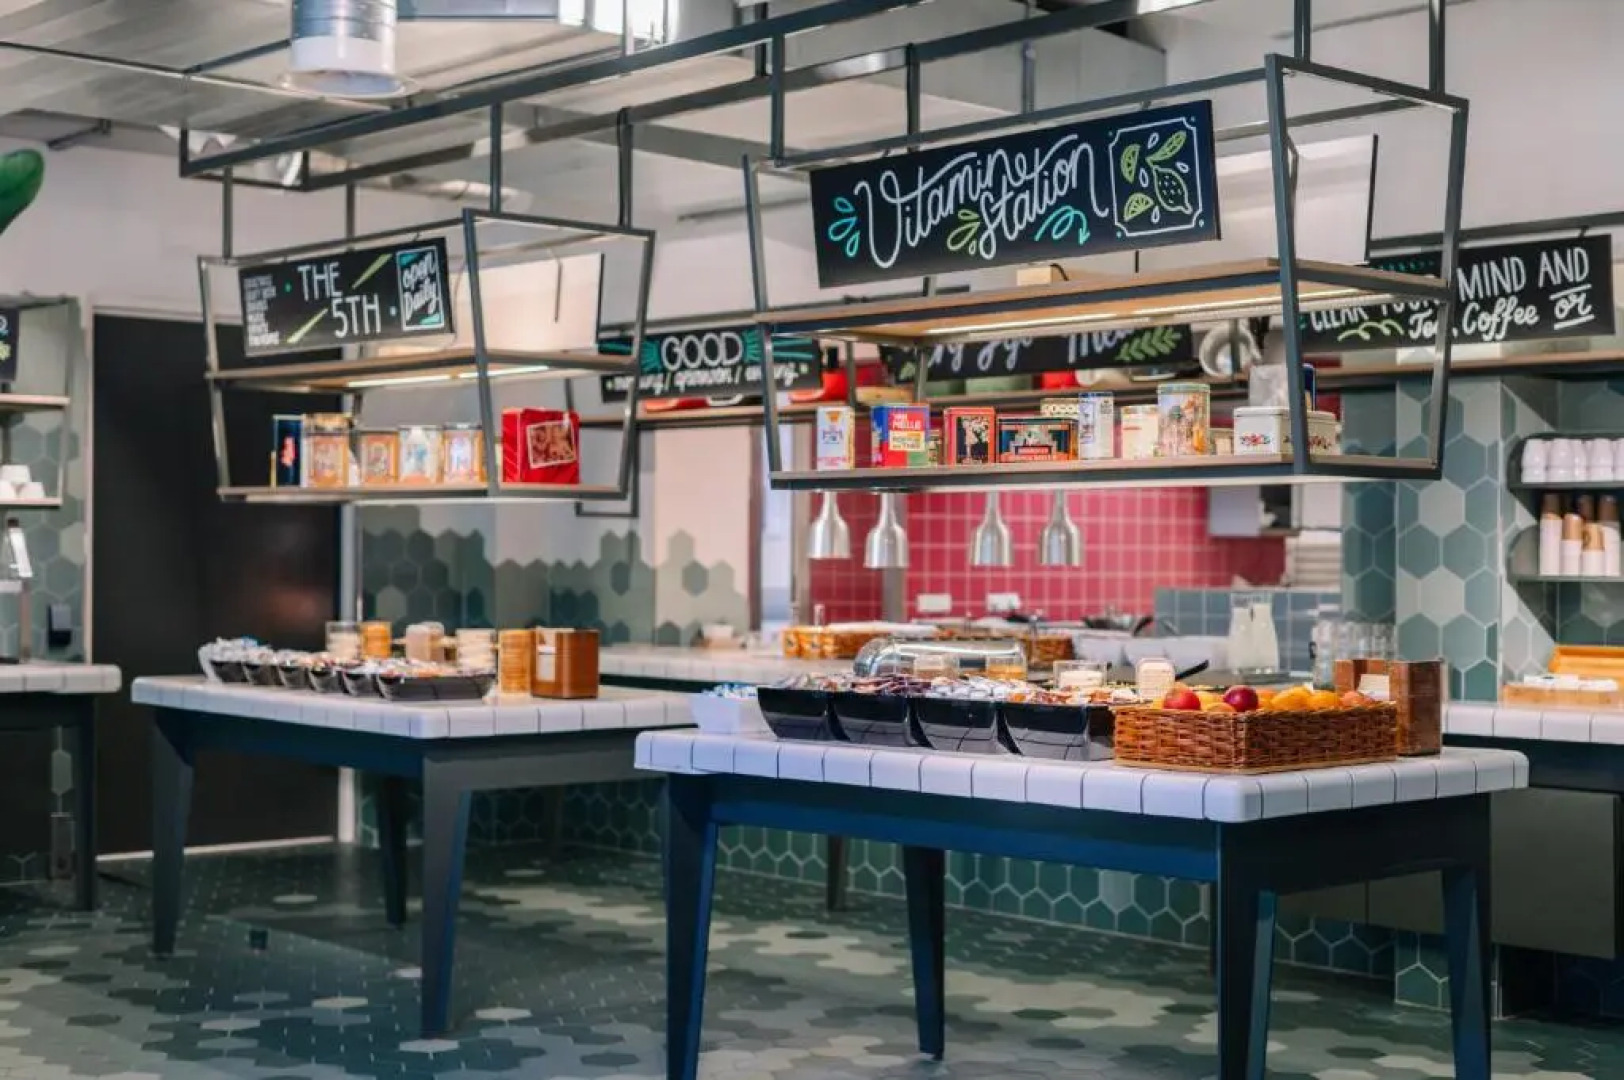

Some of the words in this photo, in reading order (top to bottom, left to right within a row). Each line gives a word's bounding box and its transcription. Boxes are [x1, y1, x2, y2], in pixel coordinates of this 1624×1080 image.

[854, 149, 1037, 269] Vitamine
[297, 261, 343, 301] THE
[1456, 256, 1526, 303] MIND
[1538, 247, 1590, 288] AND
[331, 294, 382, 338] 5TH
[1461, 295, 1540, 342] Coffee
[1554, 292, 1593, 320] or
[661, 331, 743, 371] GOOD
